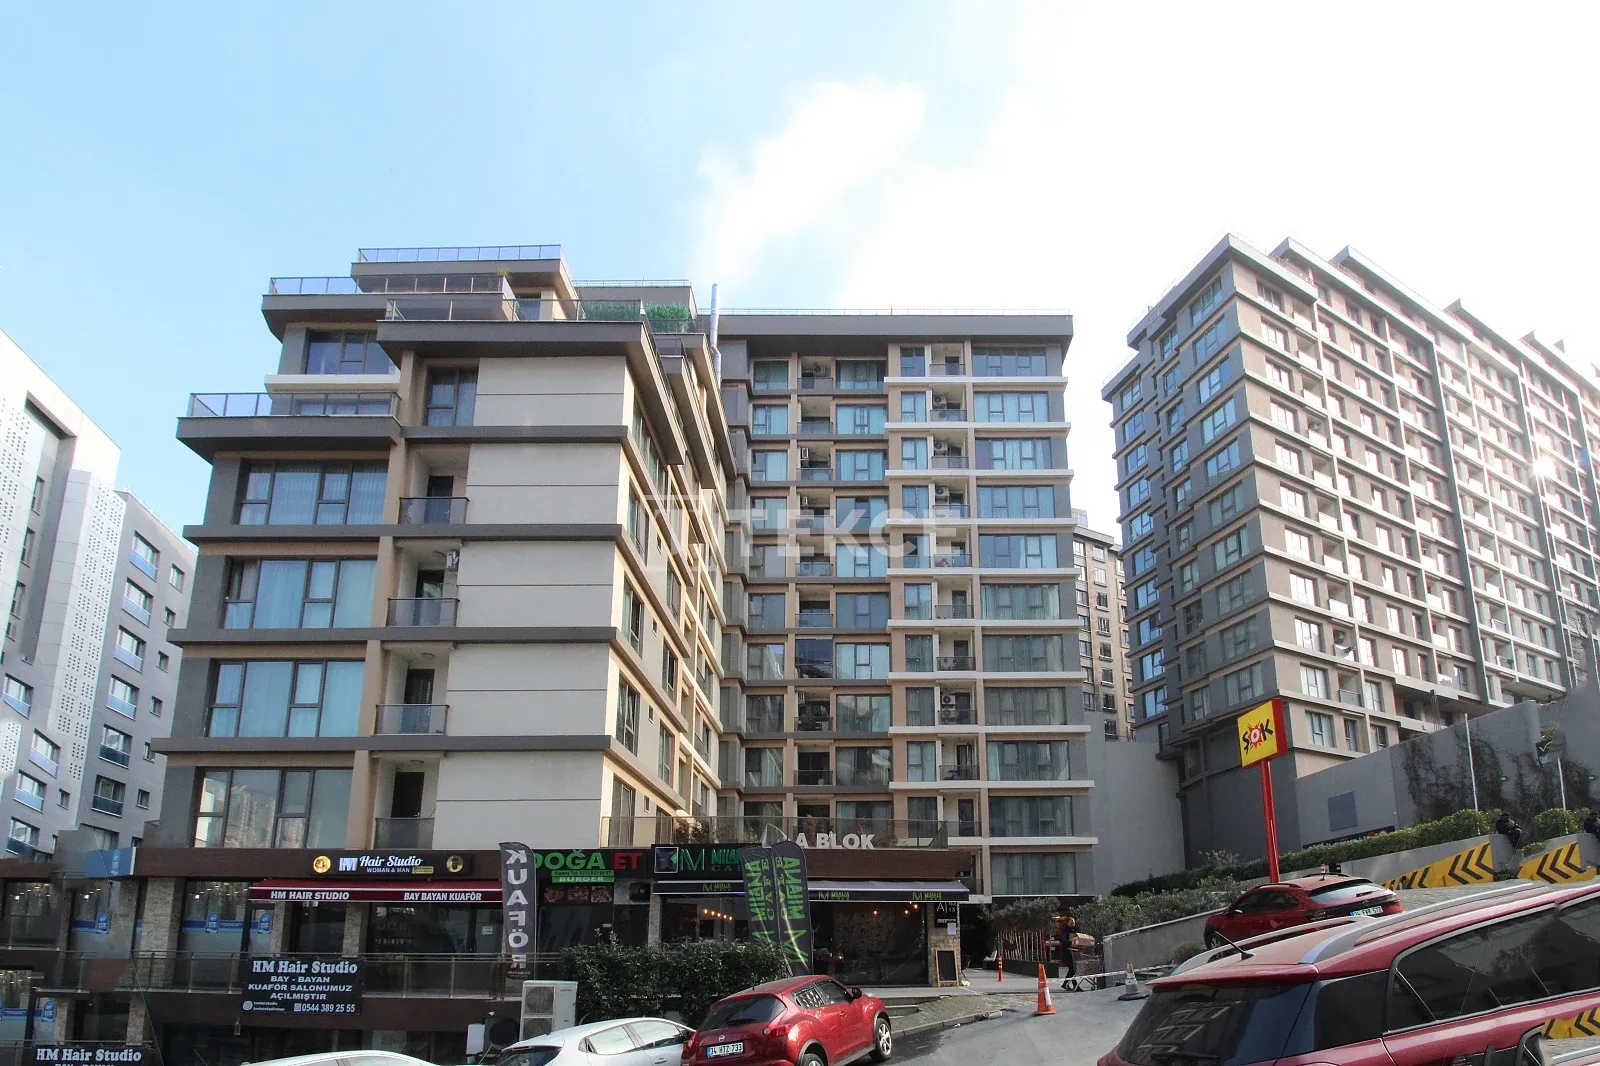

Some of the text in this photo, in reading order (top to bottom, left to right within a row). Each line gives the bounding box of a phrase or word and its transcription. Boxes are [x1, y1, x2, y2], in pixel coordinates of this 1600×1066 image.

[796, 832, 875, 849] A BLOK
[359, 856, 385, 867] Hair
[386, 855, 423, 867] Studio
[614, 853, 642, 870] ET
[270, 891, 350, 900] HM HAIR STUDIO
[403, 891, 482, 901] BAY BAYAN KUAFÖR
[252, 961, 358, 973] HM Hair Studio
[248, 983, 353, 992] KUAFÖR SALONUMUZ
[301, 1003, 356, 1013] 0544 389 25 55
[36, 1048, 142, 1062] HM Hair Studio
